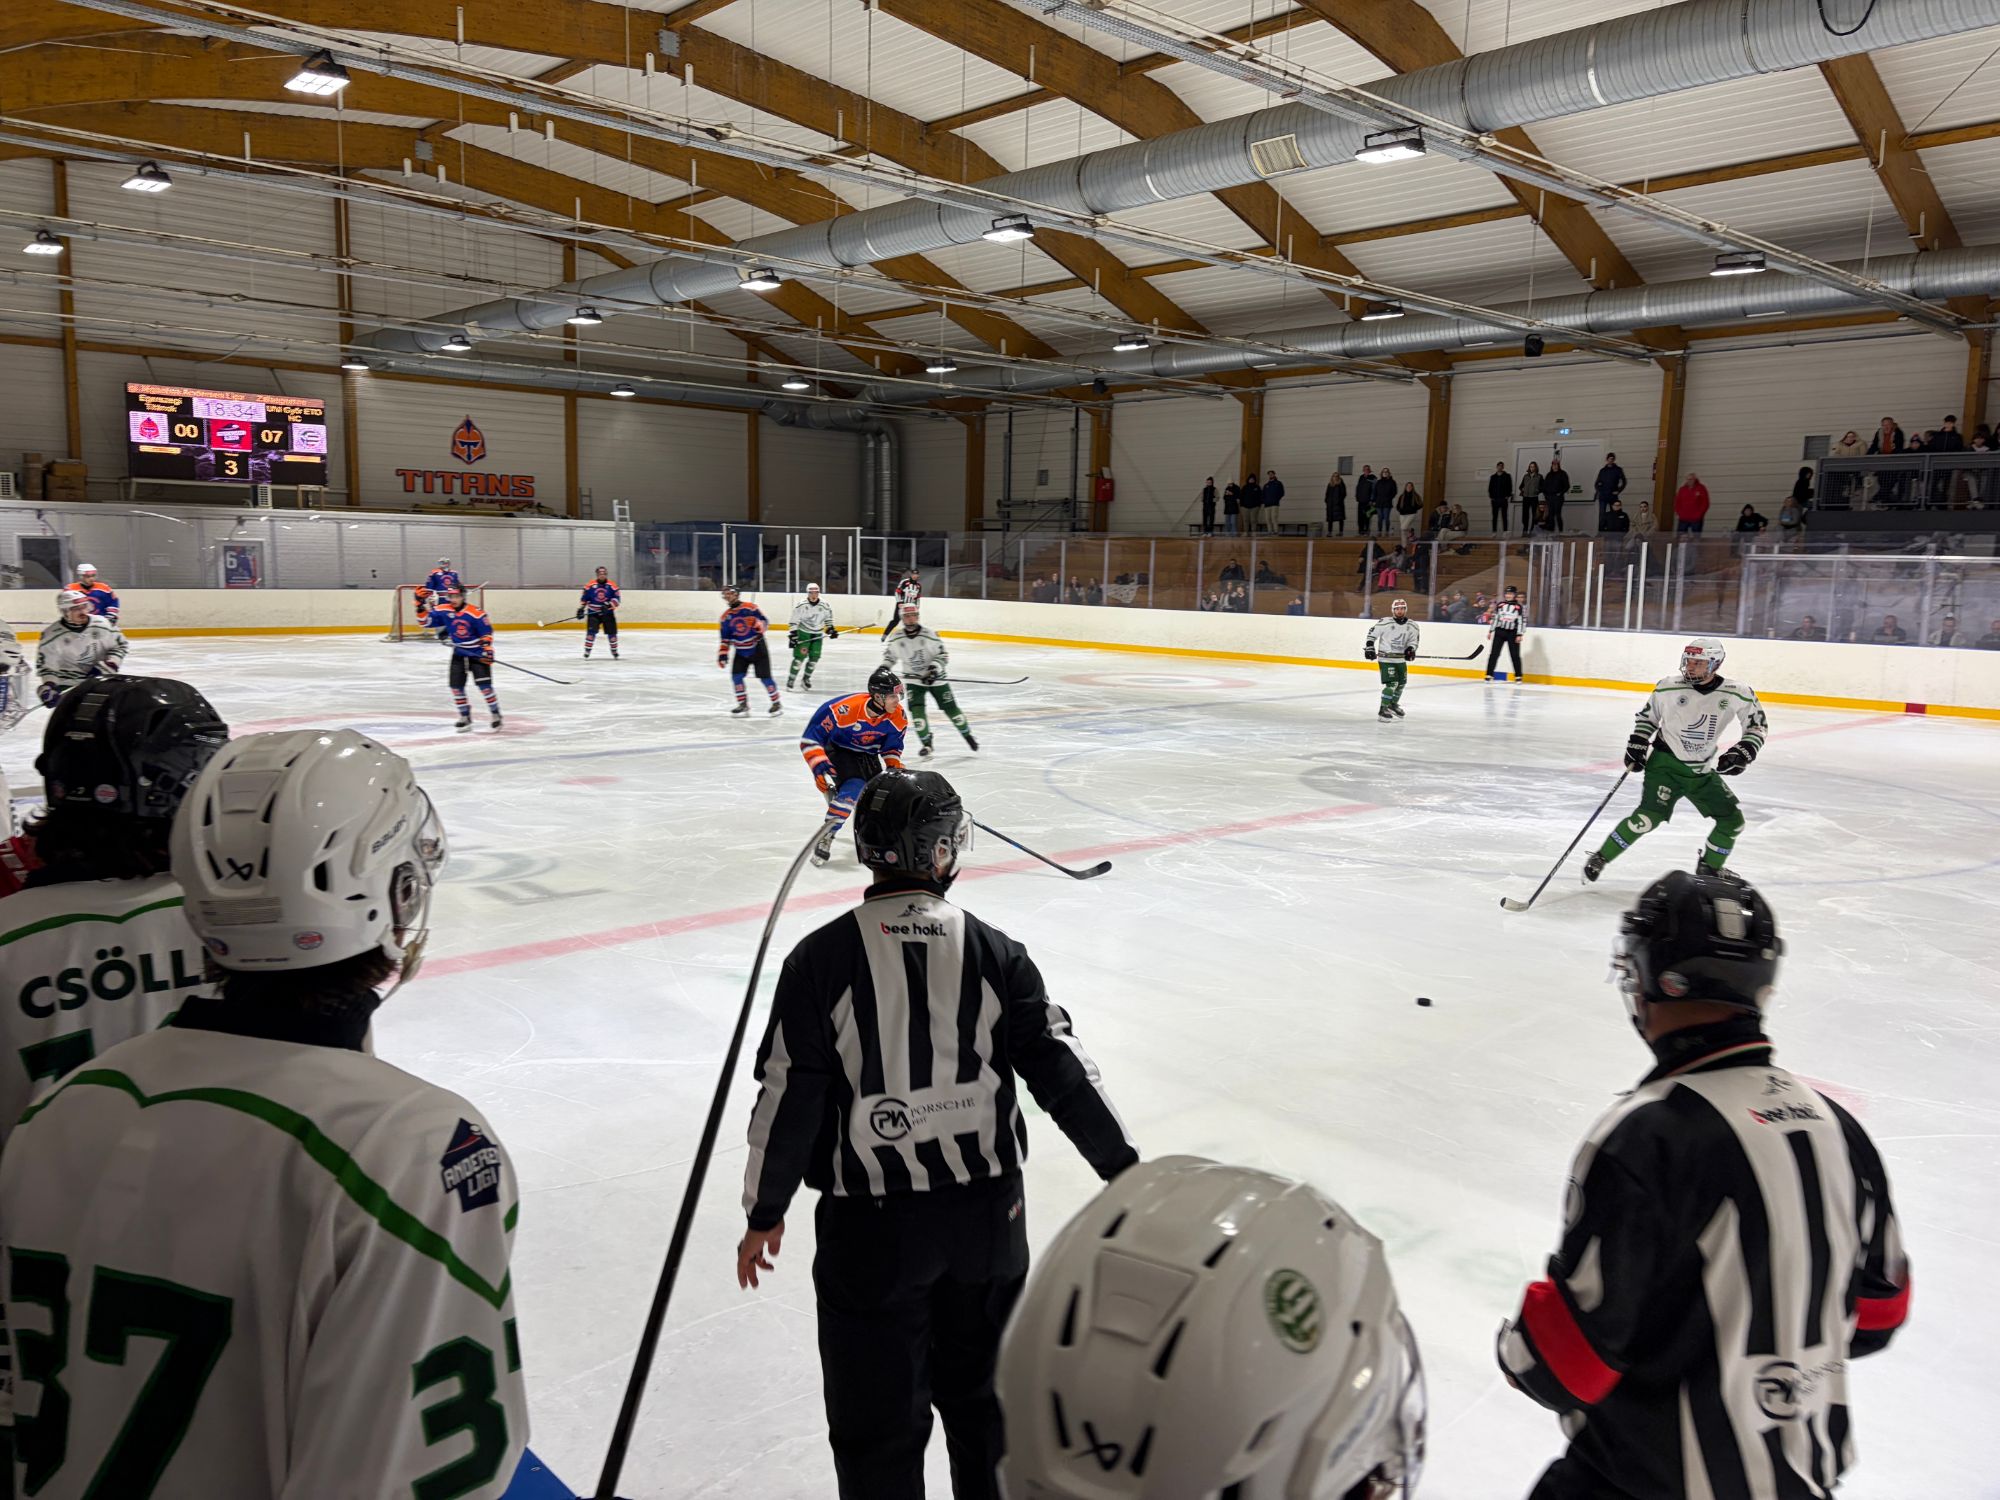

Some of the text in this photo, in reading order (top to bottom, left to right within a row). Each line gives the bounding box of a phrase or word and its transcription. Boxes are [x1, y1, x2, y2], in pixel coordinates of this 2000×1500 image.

[204, 401, 256, 419] 18:34
[174, 423, 199, 438] 00
[260, 429, 284, 443] 07
[224, 460, 239, 475] 3
[395, 468, 535, 497] TITANS
[226, 551, 238, 569] 6
[880, 921, 947, 937] bee hoki.
[910, 1097, 976, 1118] PORSCHE
[443, 1147, 501, 1190] ANDERS
[8, 1246, 234, 1500] 37
